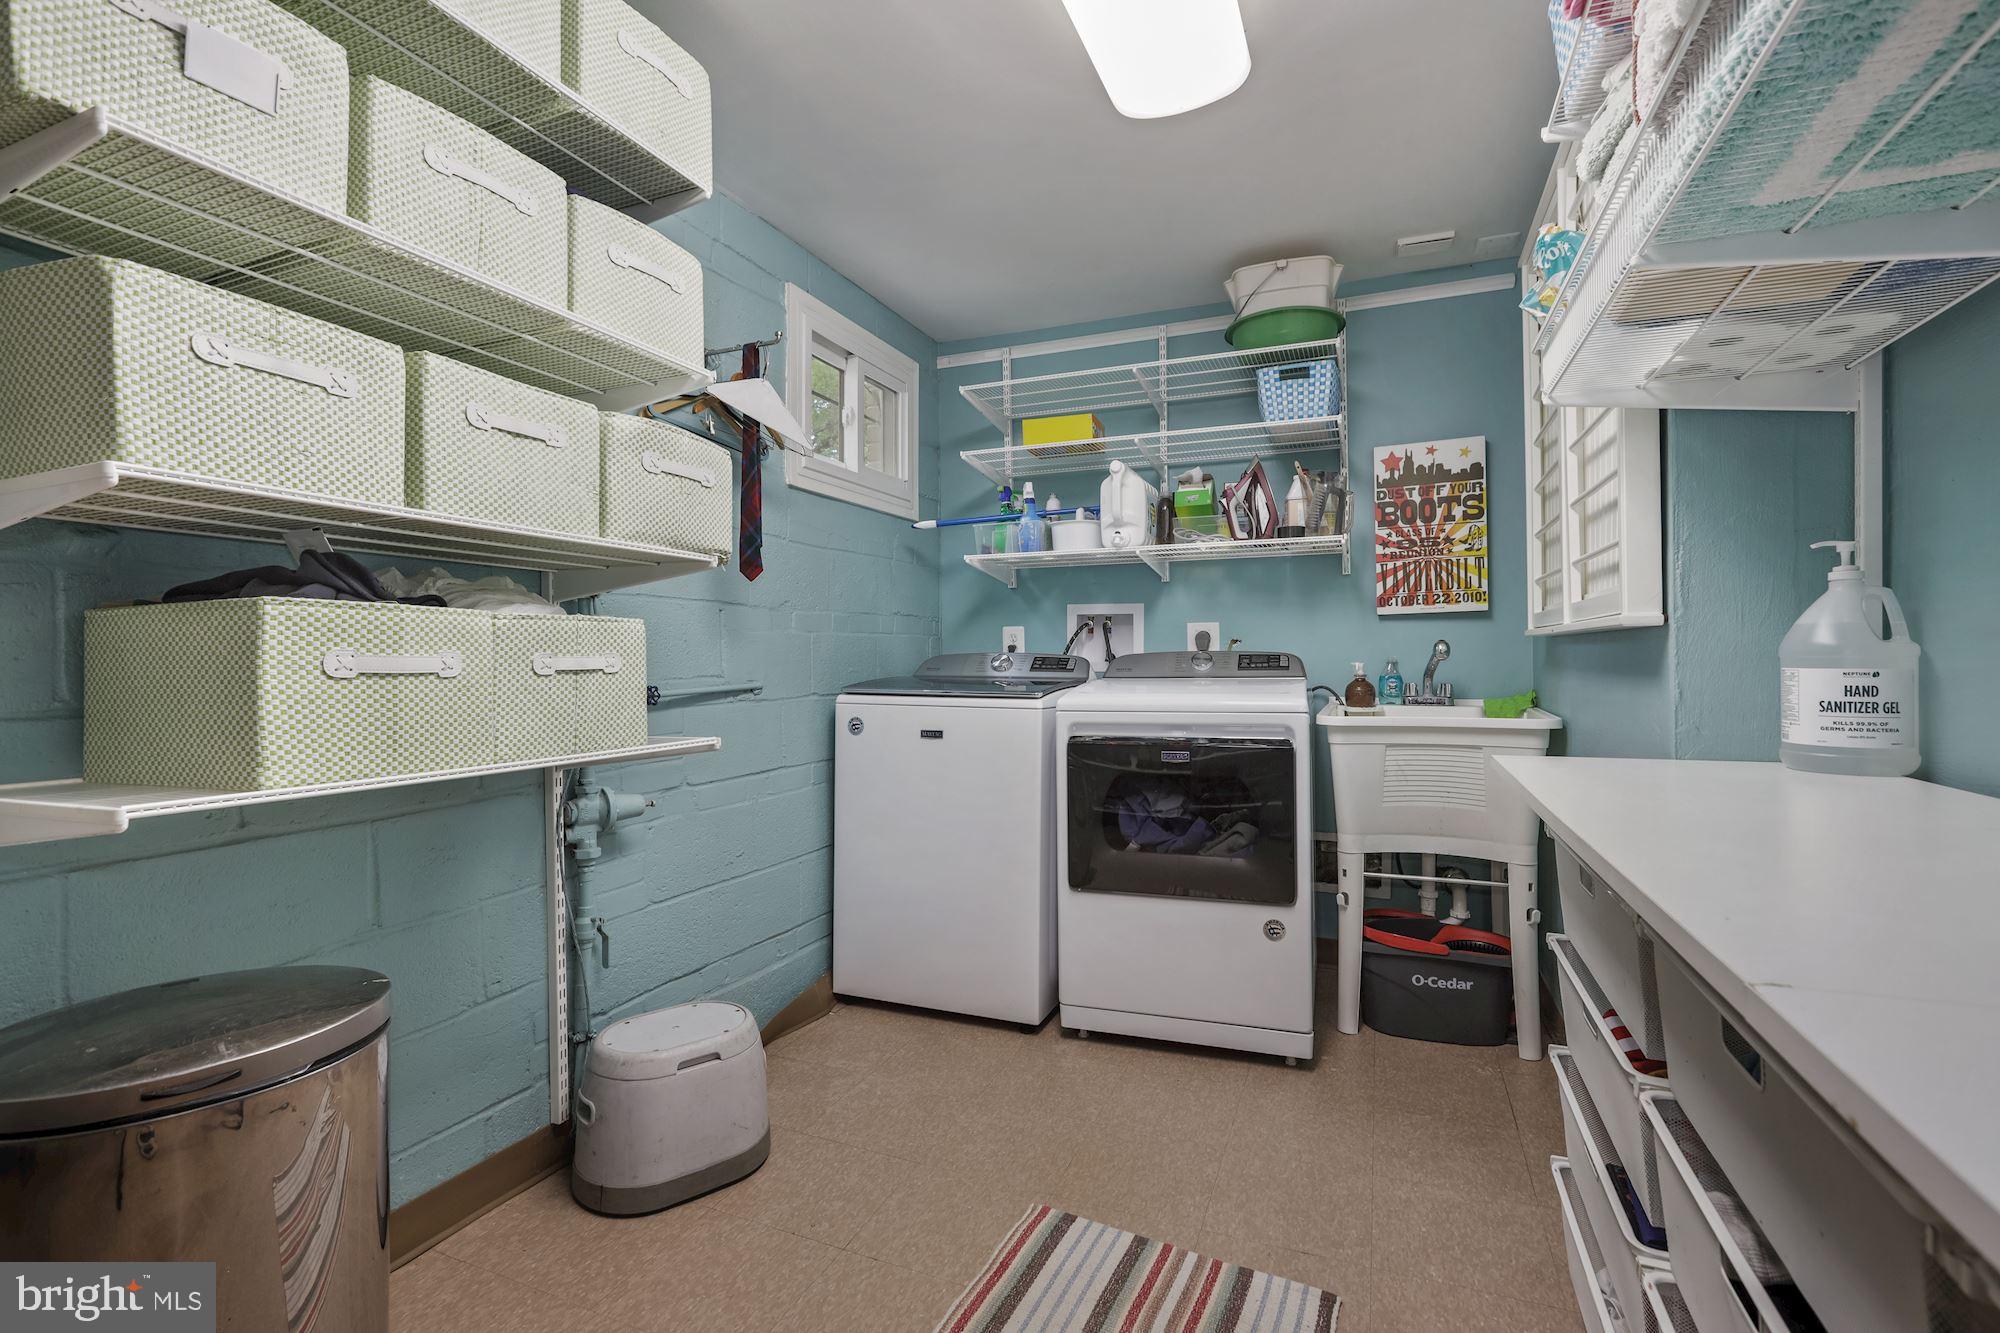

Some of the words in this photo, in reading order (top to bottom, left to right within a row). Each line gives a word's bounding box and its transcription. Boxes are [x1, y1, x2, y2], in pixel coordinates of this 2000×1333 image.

[1376, 487, 1416, 501] DUST
[1418, 484, 1447, 497] OFF
[1449, 481, 1484, 495] YOUR
[1377, 493, 1485, 528] BOOTS
[1395, 527, 1422, 538] CLASS
[1425, 527, 1436, 536] OF
[1390, 547, 1445, 559] REUNION
[1380, 556, 1485, 594] VANDERBILT
[1379, 593, 1429, 607] OCTOBER
[1844, 685, 1879, 698] HAND
[1819, 700, 1880, 714] SANITIZER
[1882, 701, 1901, 715] GEL
